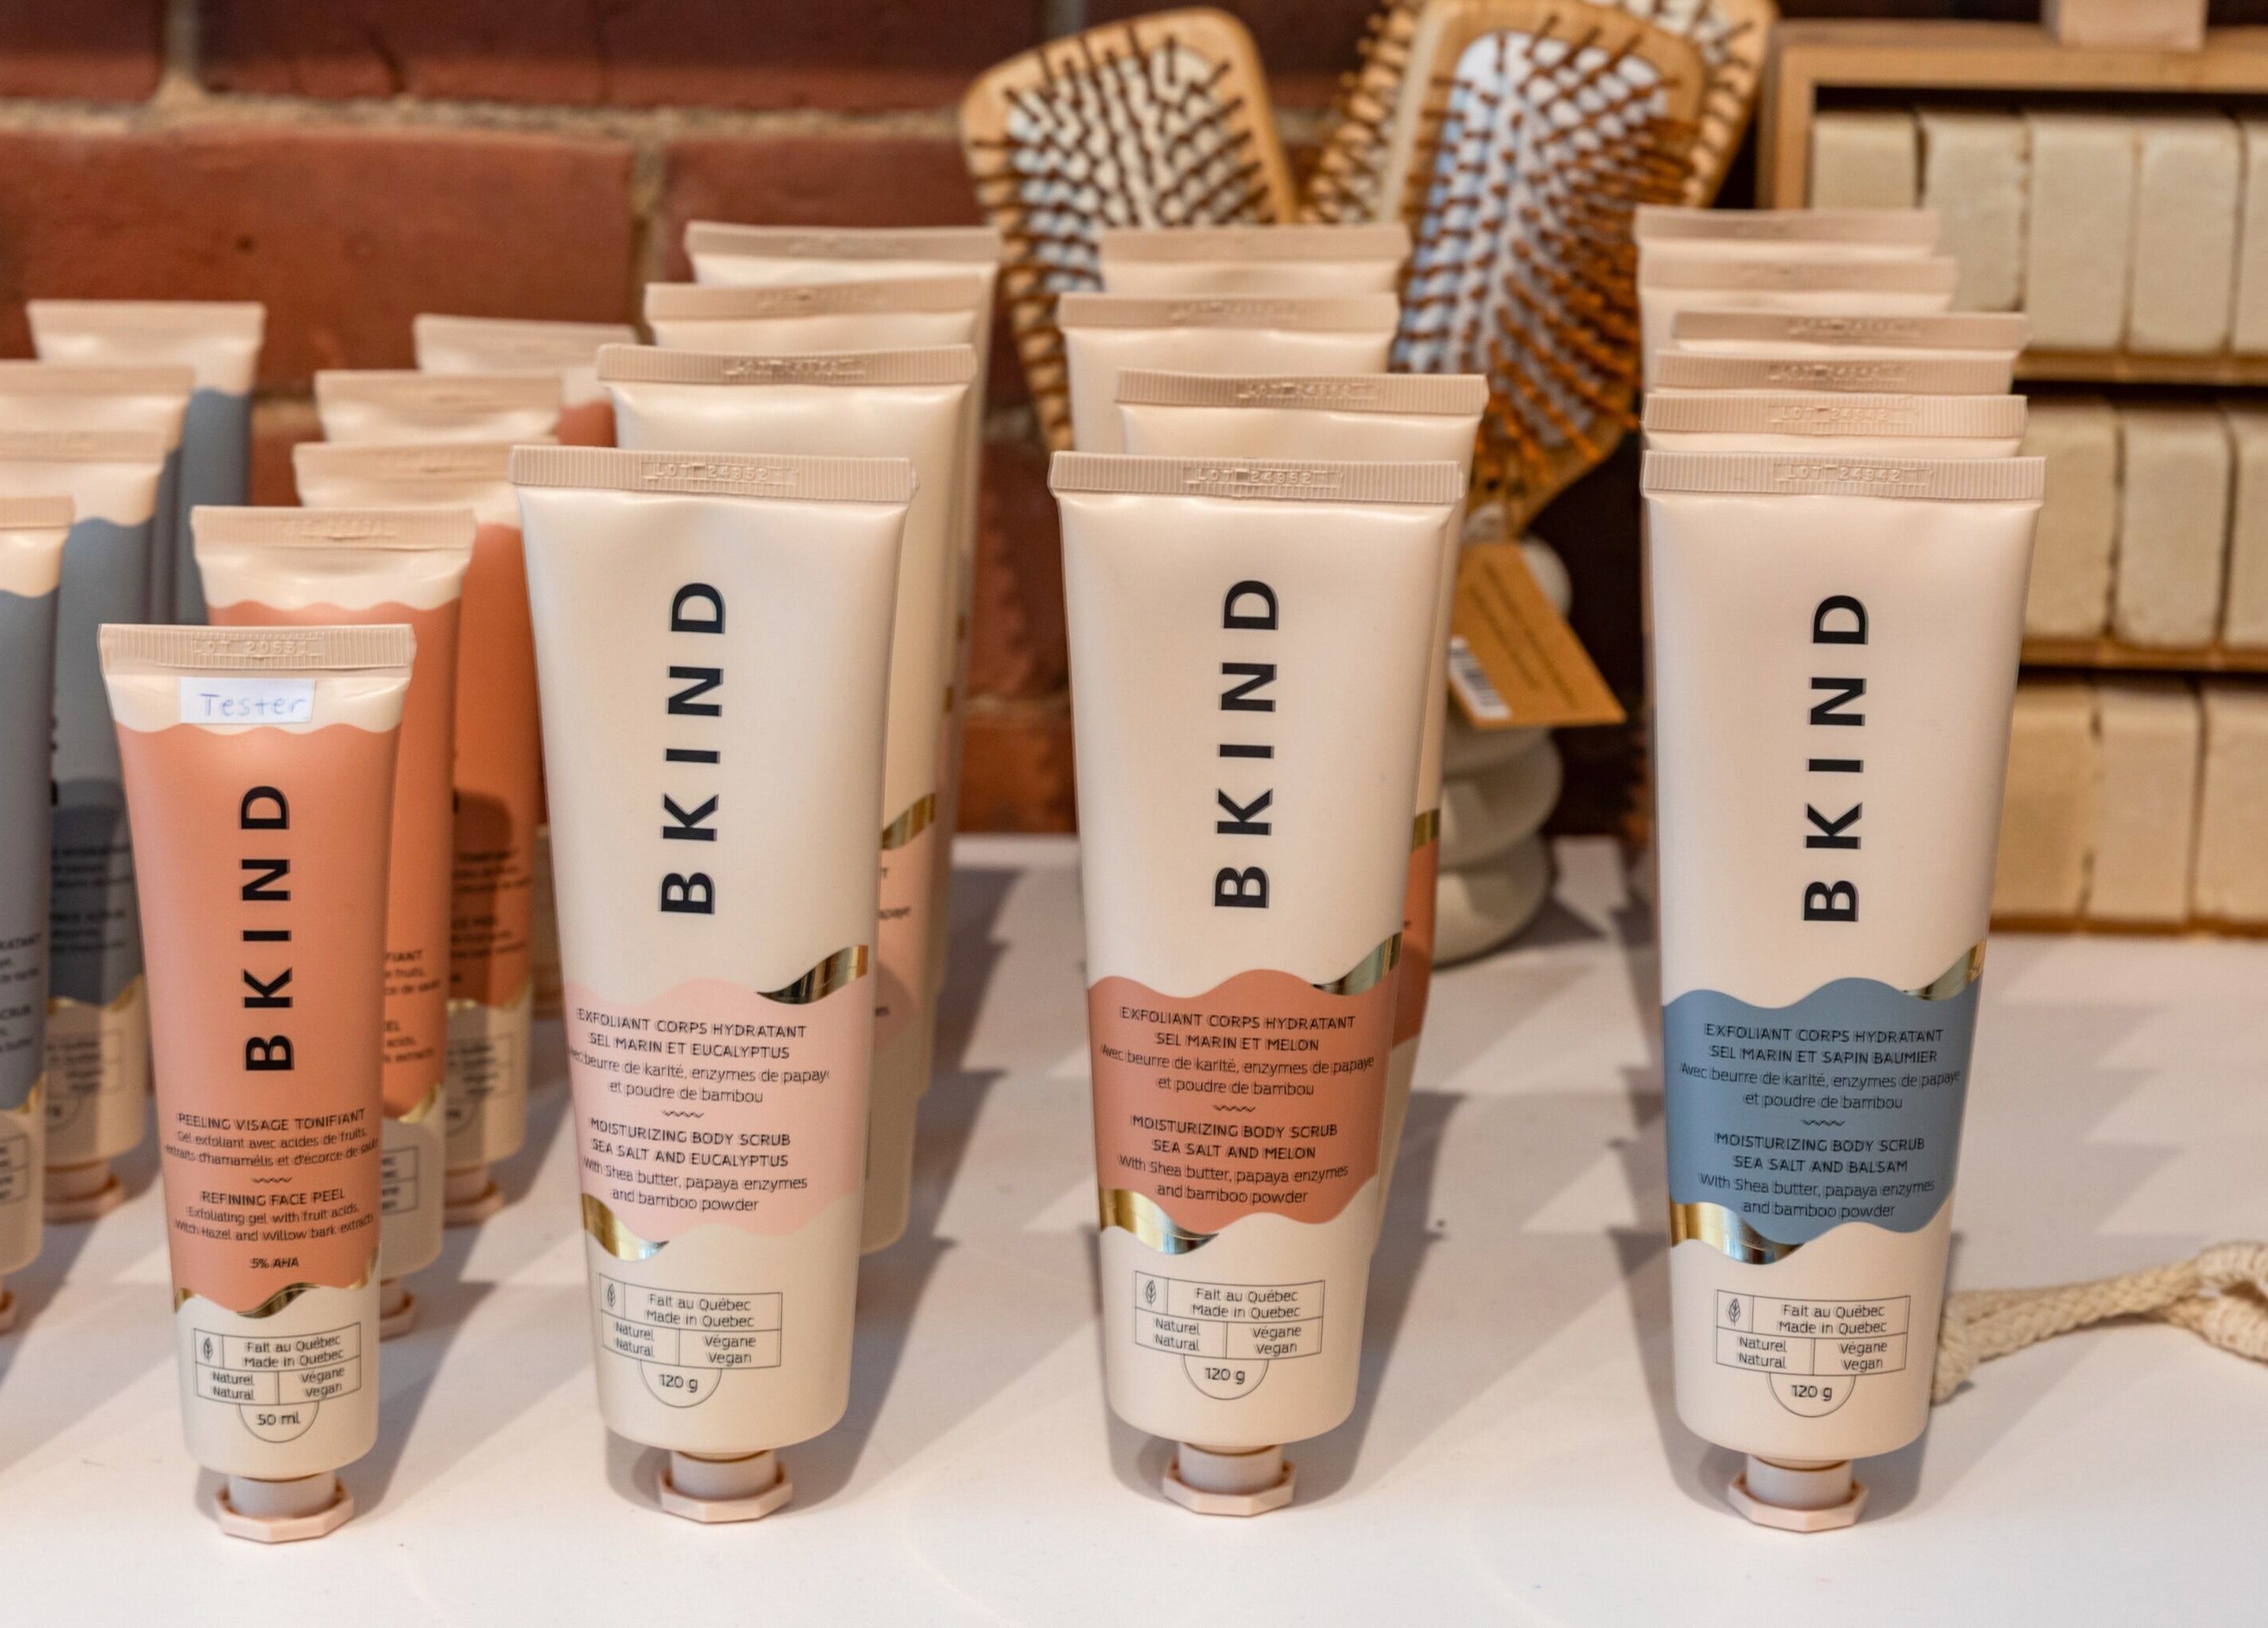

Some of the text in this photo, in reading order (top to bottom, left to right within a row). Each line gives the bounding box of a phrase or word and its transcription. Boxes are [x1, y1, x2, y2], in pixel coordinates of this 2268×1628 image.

[199, 693, 306, 716] Tester
[659, 583, 726, 915] BKIND
[1213, 580, 1279, 908] BKIND
[1801, 595, 1868, 922] BKIND
[240, 784, 295, 1071] BKIND
[577, 1009, 807, 1037] EXFOLIANT CORPS HYDRATANT
[1121, 1007, 1356, 1030] EXFOLIANT CORPS HYDRATANT
[1155, 1033, 1319, 1051] SEL MARIN ET MELON
[1704, 1024, 1943, 1043] EXFOLIANT CORPS HYDRATANT
[589, 1032, 790, 1058] SEL MARIN ET EUCALYPTUS
[1128, 1050, 1170, 1067] beurre
[1174, 1056, 1191, 1070] de
[1196, 1057, 1239, 1075] karité,
[1244, 1060, 1308, 1076] enzymes
[1312, 1060, 1328, 1074] de
[1333, 1056, 1374, 1076] papaye
[1710, 1046, 1937, 1064] SEL MARIN ET SAPIN BAUMIER
[608, 1081, 763, 1103] et poudre de bambou
[1158, 1077, 1314, 1096] et poudre de bambou
[1744, 1093, 1903, 1109] et poudre de bambou
[178, 1108, 366, 1131] PEELING VISAGE TONIFIANT
[1132, 1115, 1338, 1138] MOISTURIZING BODY SCRUB
[591, 1118, 790, 1145] MOISTURIZING BODY SCRUB
[1153, 1139, 1316, 1159] SEA SALT AND MELON
[1715, 1132, 1925, 1152] MOISTURIZING BODY SCRUB
[591, 1138, 789, 1167] SEA SALT AND EUCALYPTUS
[1150, 1160, 1181, 1177] Shea
[1187, 1164, 1232, 1182] butter,
[1237, 1169, 1289, 1185] papaya
[1294, 1164, 1348, 1183] enzymes
[1733, 1156, 1907, 1174] SEA SALT AND BALSAM
[201, 1188, 345, 1205] REFINING FACE PEEL
[1157, 1184, 1309, 1205] and bamboo powder
[1735, 1178, 1769, 1194] Shea
[1774, 1180, 1820, 1198] butter,
[1825, 1184, 1877, 1199] papaya
[1883, 1180, 1935, 1198] enzymes
[612, 1189, 759, 1213] and bamboo powder
[1742, 1201, 1894, 1220] and bamboo powder
[251, 1258, 299, 1268] 5% AHA
[650, 1294, 751, 1311] Fait au Québec
[1196, 1288, 1298, 1303] Fait au Québec
[647, 1310, 754, 1328] Made in Quebec
[1192, 1304, 1301, 1318] Made in Quebec
[1783, 1304, 1885, 1319] Fait au Québec
[616, 1322, 655, 1341] Naturel
[1155, 1318, 1200, 1335] Naturel
[1252, 1325, 1301, 1341] Végane
[1779, 1321, 1887, 1335] Made in Quebec
[246, 1335, 340, 1352] Fait au Québec
[616, 1338, 655, 1357] Natural
[704, 1335, 757, 1350] Végane
[1155, 1334, 1200, 1351] Natural
[1256, 1342, 1297, 1357] Vegan
[1739, 1337, 1787, 1352] Naturel
[1839, 1341, 1887, 1357] Végane
[245, 1350, 344, 1367] Made in Quebec
[707, 1352, 752, 1367] Vegan
[1739, 1352, 1786, 1369] Natural
[212, 1371, 253, 1385] Naturel
[659, 1374, 698, 1393] 120 g
[1205, 1367, 1245, 1385] 120 g
[212, 1386, 254, 1401] Natural
[1792, 1385, 1832, 1401] 120 g
[257, 1412, 300, 1426] 50 ml
